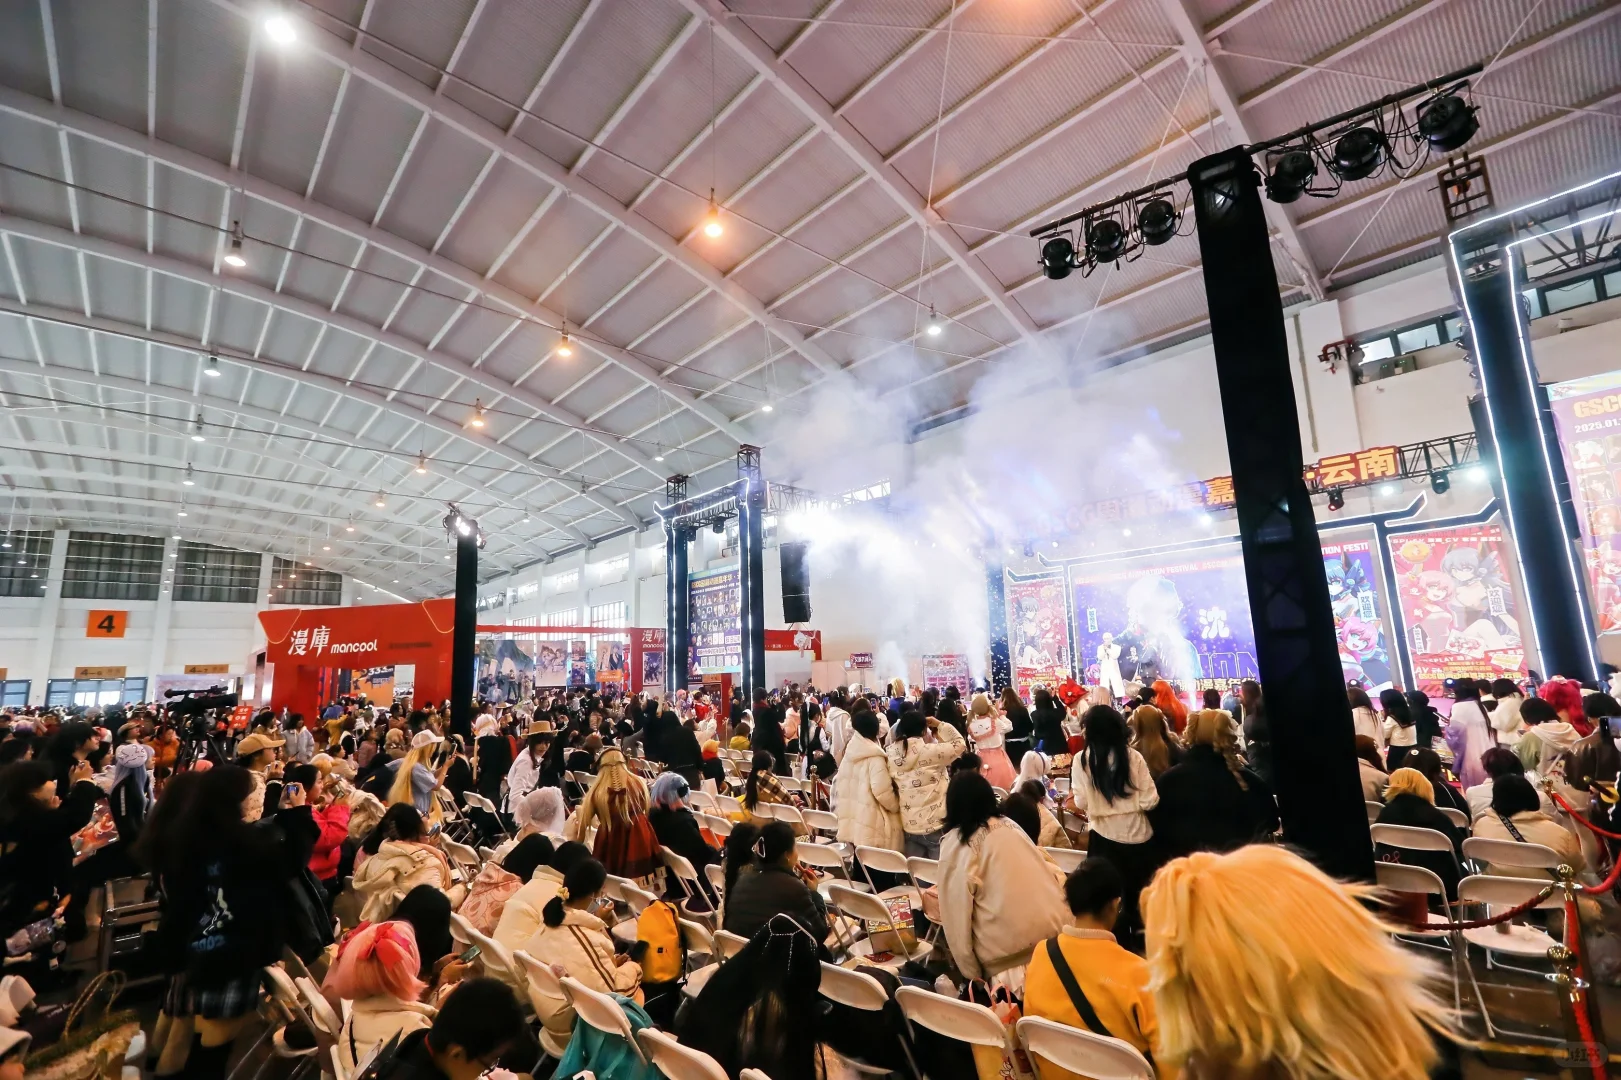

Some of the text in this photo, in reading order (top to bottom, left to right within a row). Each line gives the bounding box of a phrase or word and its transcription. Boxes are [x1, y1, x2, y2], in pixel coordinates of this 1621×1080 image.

[1166, 563, 1199, 575] FESTIVAL
[97, 614, 116, 633] 4
[330, 639, 378, 654] mancool
